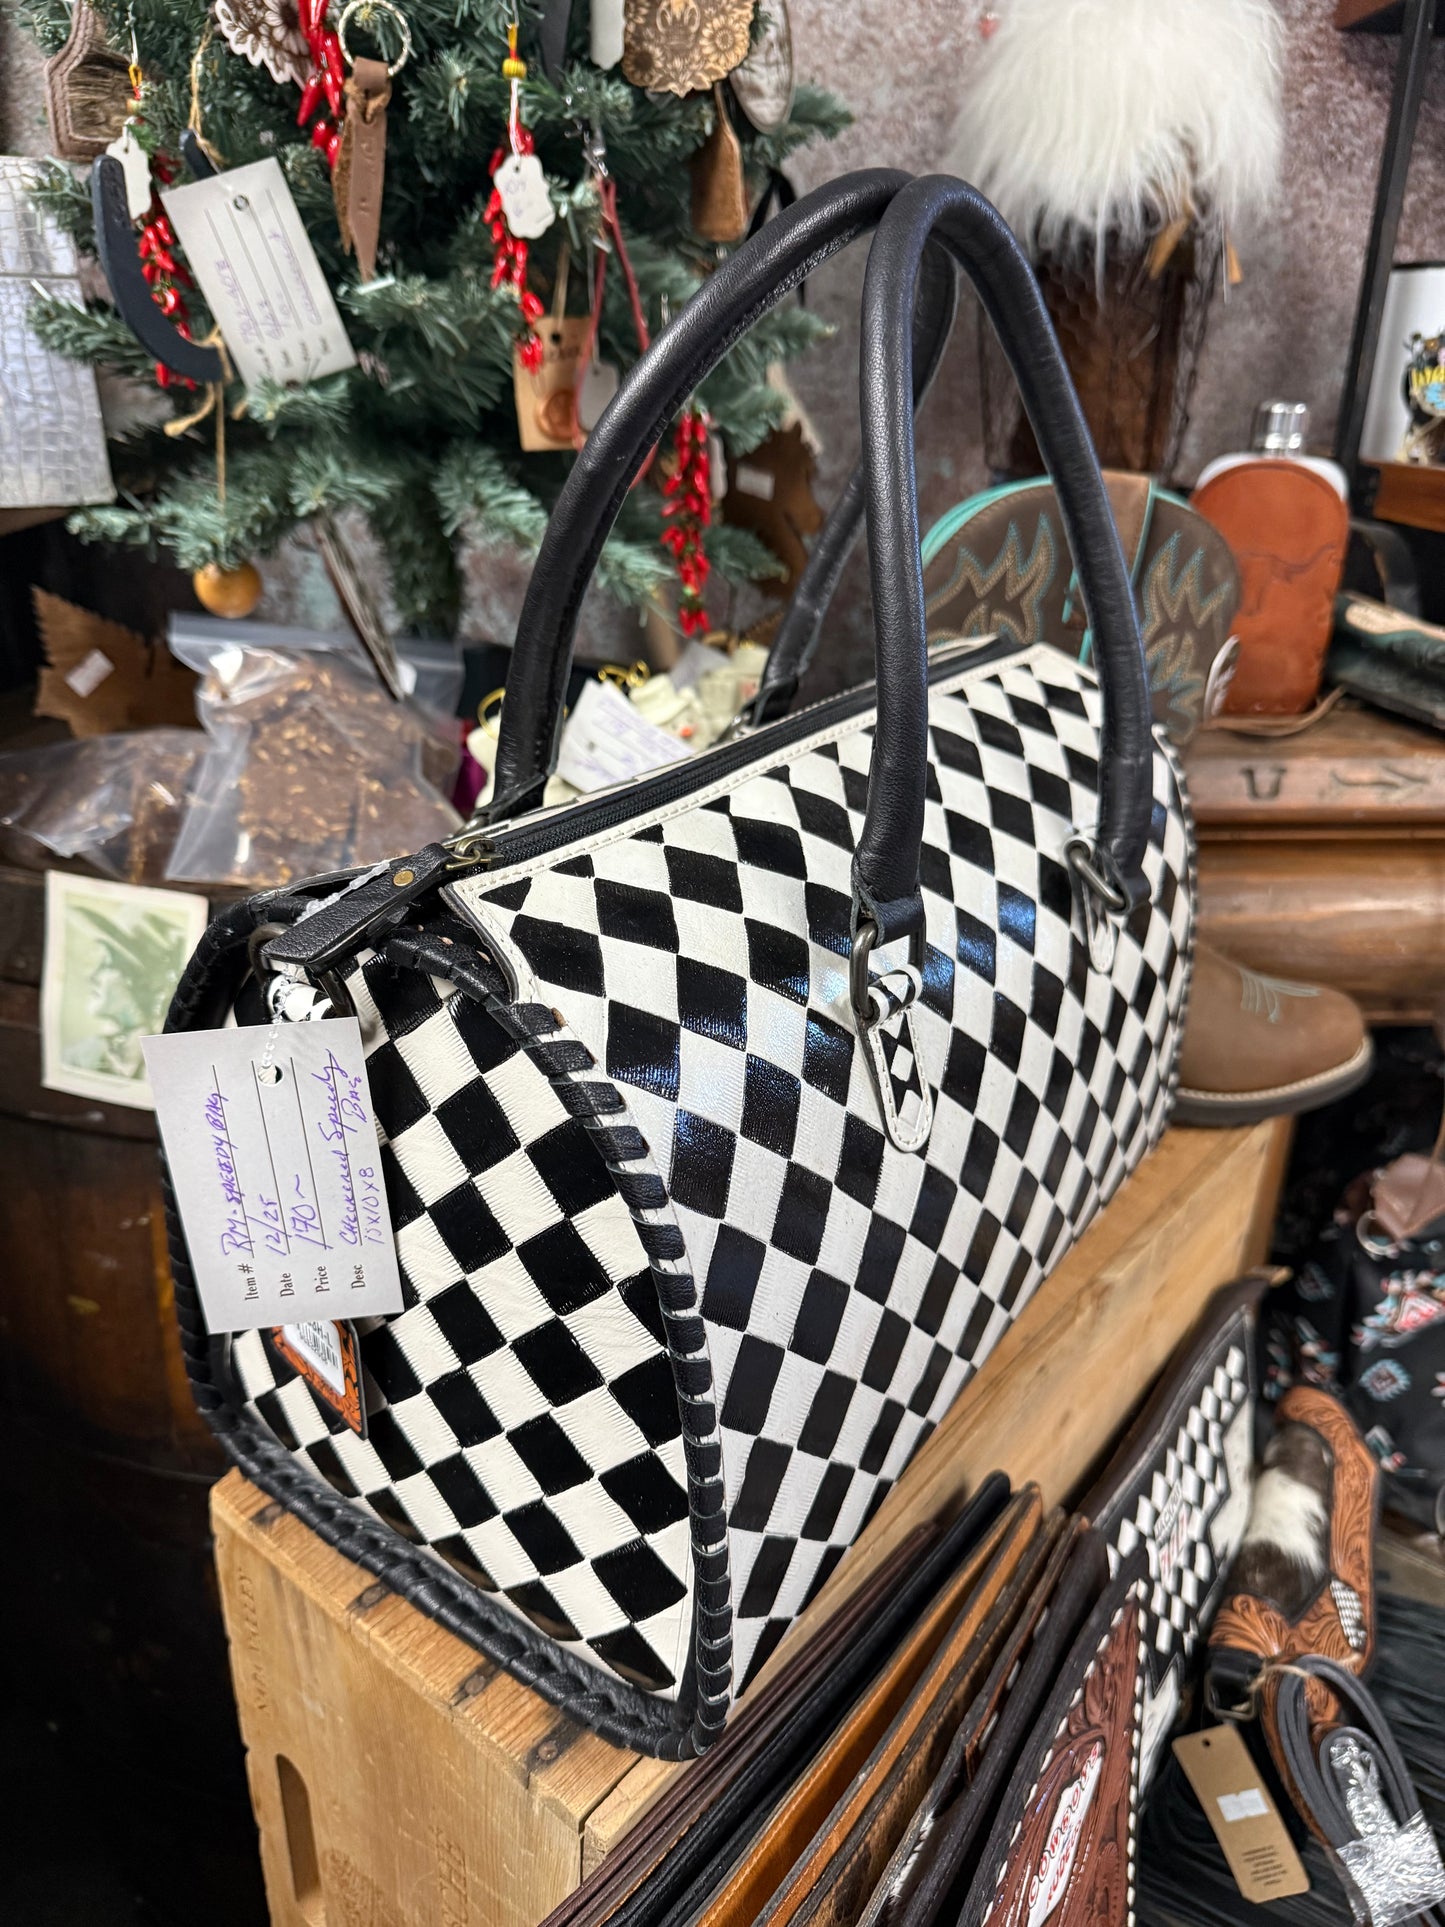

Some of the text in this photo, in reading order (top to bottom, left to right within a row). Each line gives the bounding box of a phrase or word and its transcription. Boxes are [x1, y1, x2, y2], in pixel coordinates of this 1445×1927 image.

[245, 1193, 296, 1298] Date 12/25
[244, 1276, 260, 1301] Item
[315, 1265, 331, 1293] Price
[351, 1264, 367, 1290] Desc
